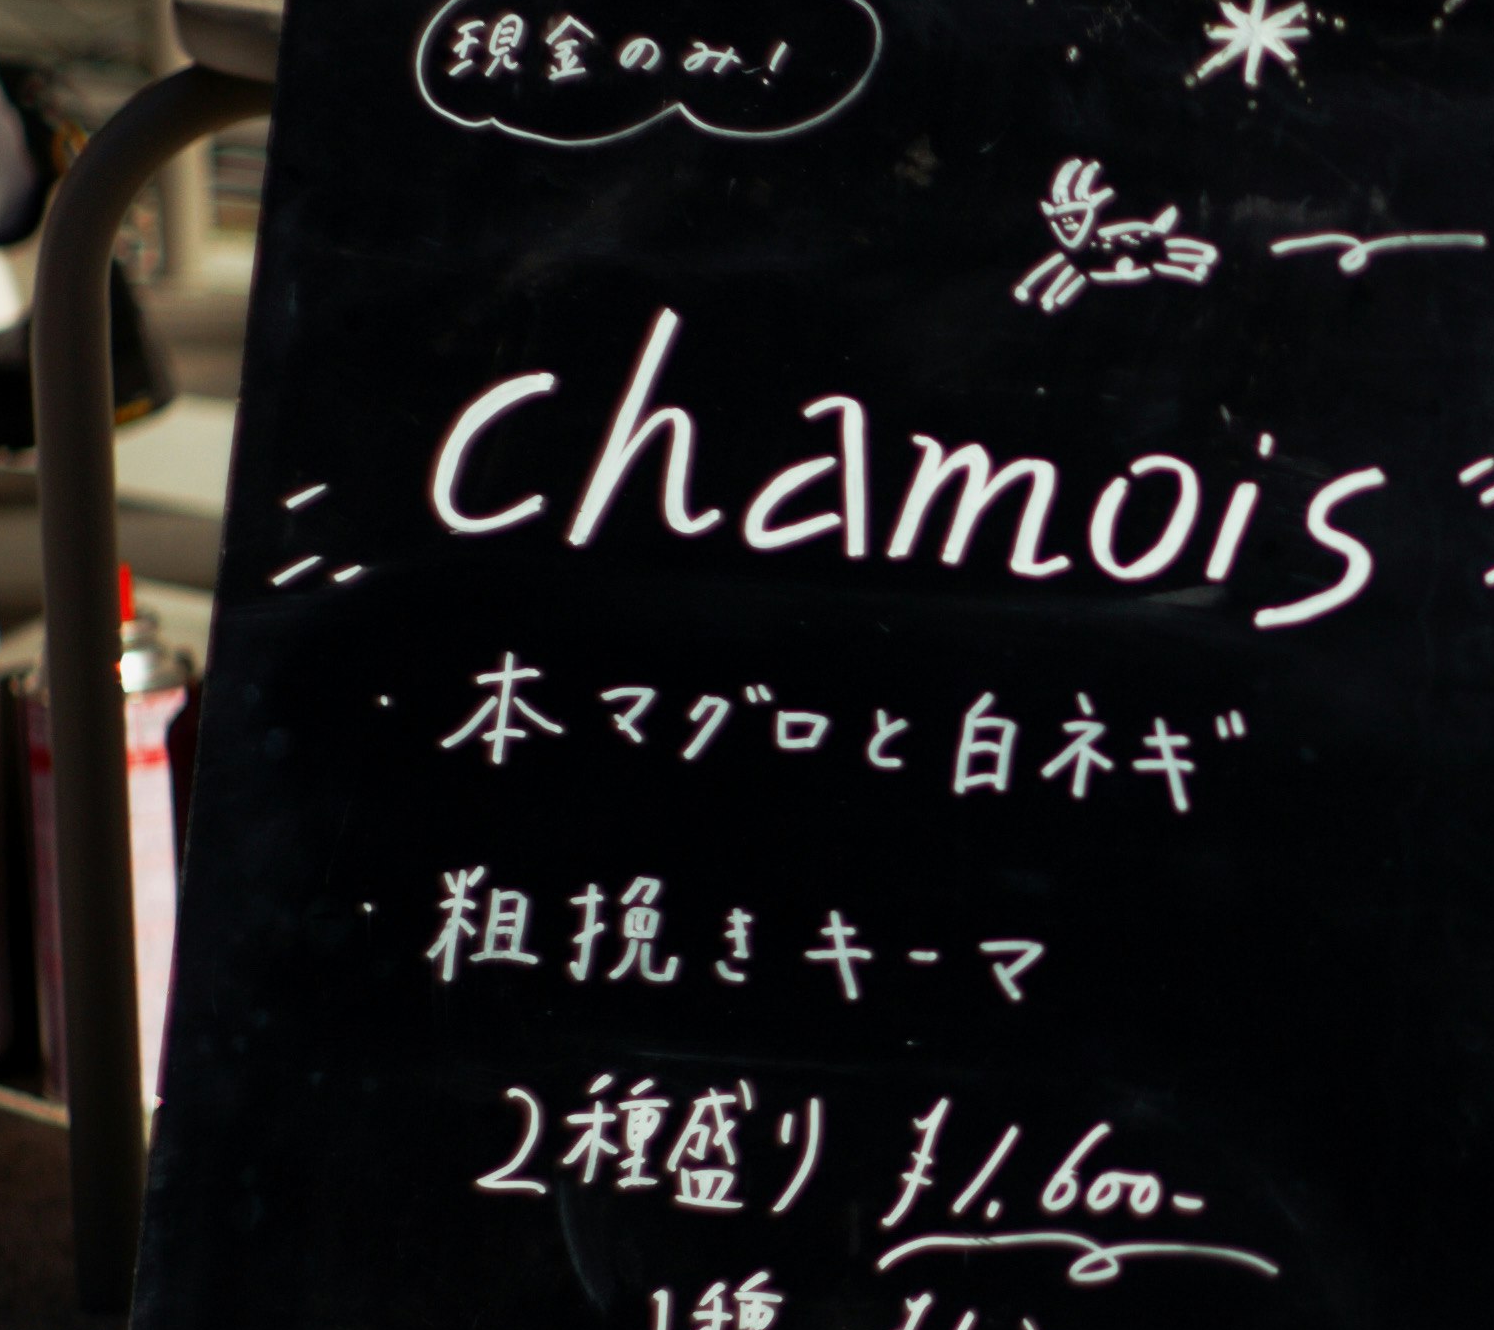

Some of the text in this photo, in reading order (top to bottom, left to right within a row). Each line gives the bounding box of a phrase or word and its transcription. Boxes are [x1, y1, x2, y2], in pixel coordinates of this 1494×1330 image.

[429, 306, 1387, 630] chamois
[474, 1072, 822, 1214] 2種盛り
